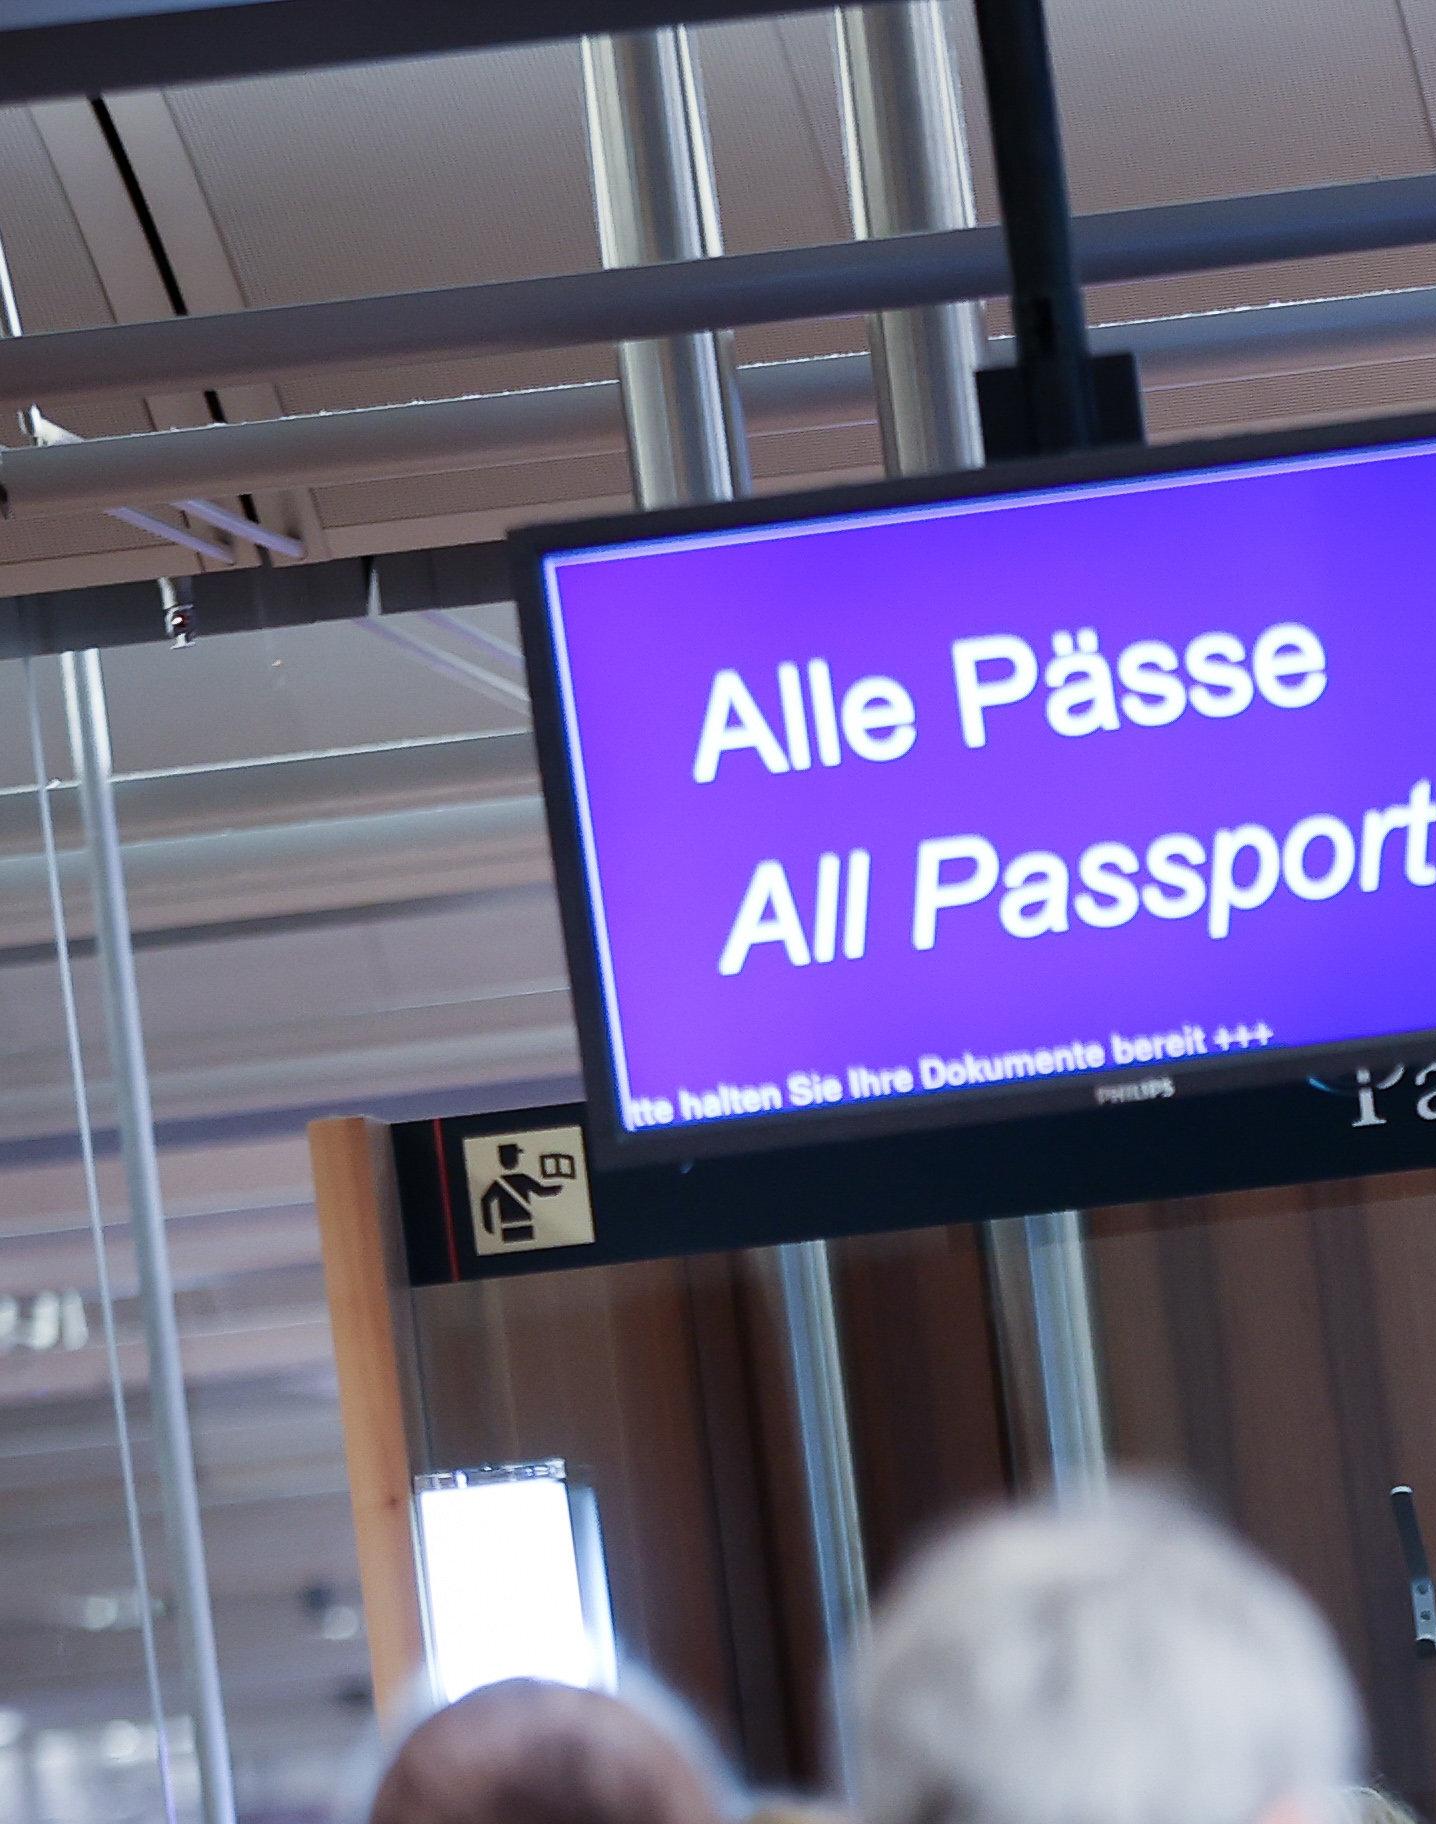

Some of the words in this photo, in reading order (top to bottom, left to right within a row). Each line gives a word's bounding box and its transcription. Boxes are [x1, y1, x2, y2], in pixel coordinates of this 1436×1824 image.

[692, 658, 917, 784] Alle
[951, 622, 1328, 748] Pässe
[718, 848, 871, 976] All
[678, 1085, 784, 1122] halten
[787, 1071, 844, 1106] Sie
[847, 1063, 914, 1099] Ihre
[919, 1041, 1106, 1090] Dokumente
[1110, 1023, 1209, 1065] bereit
